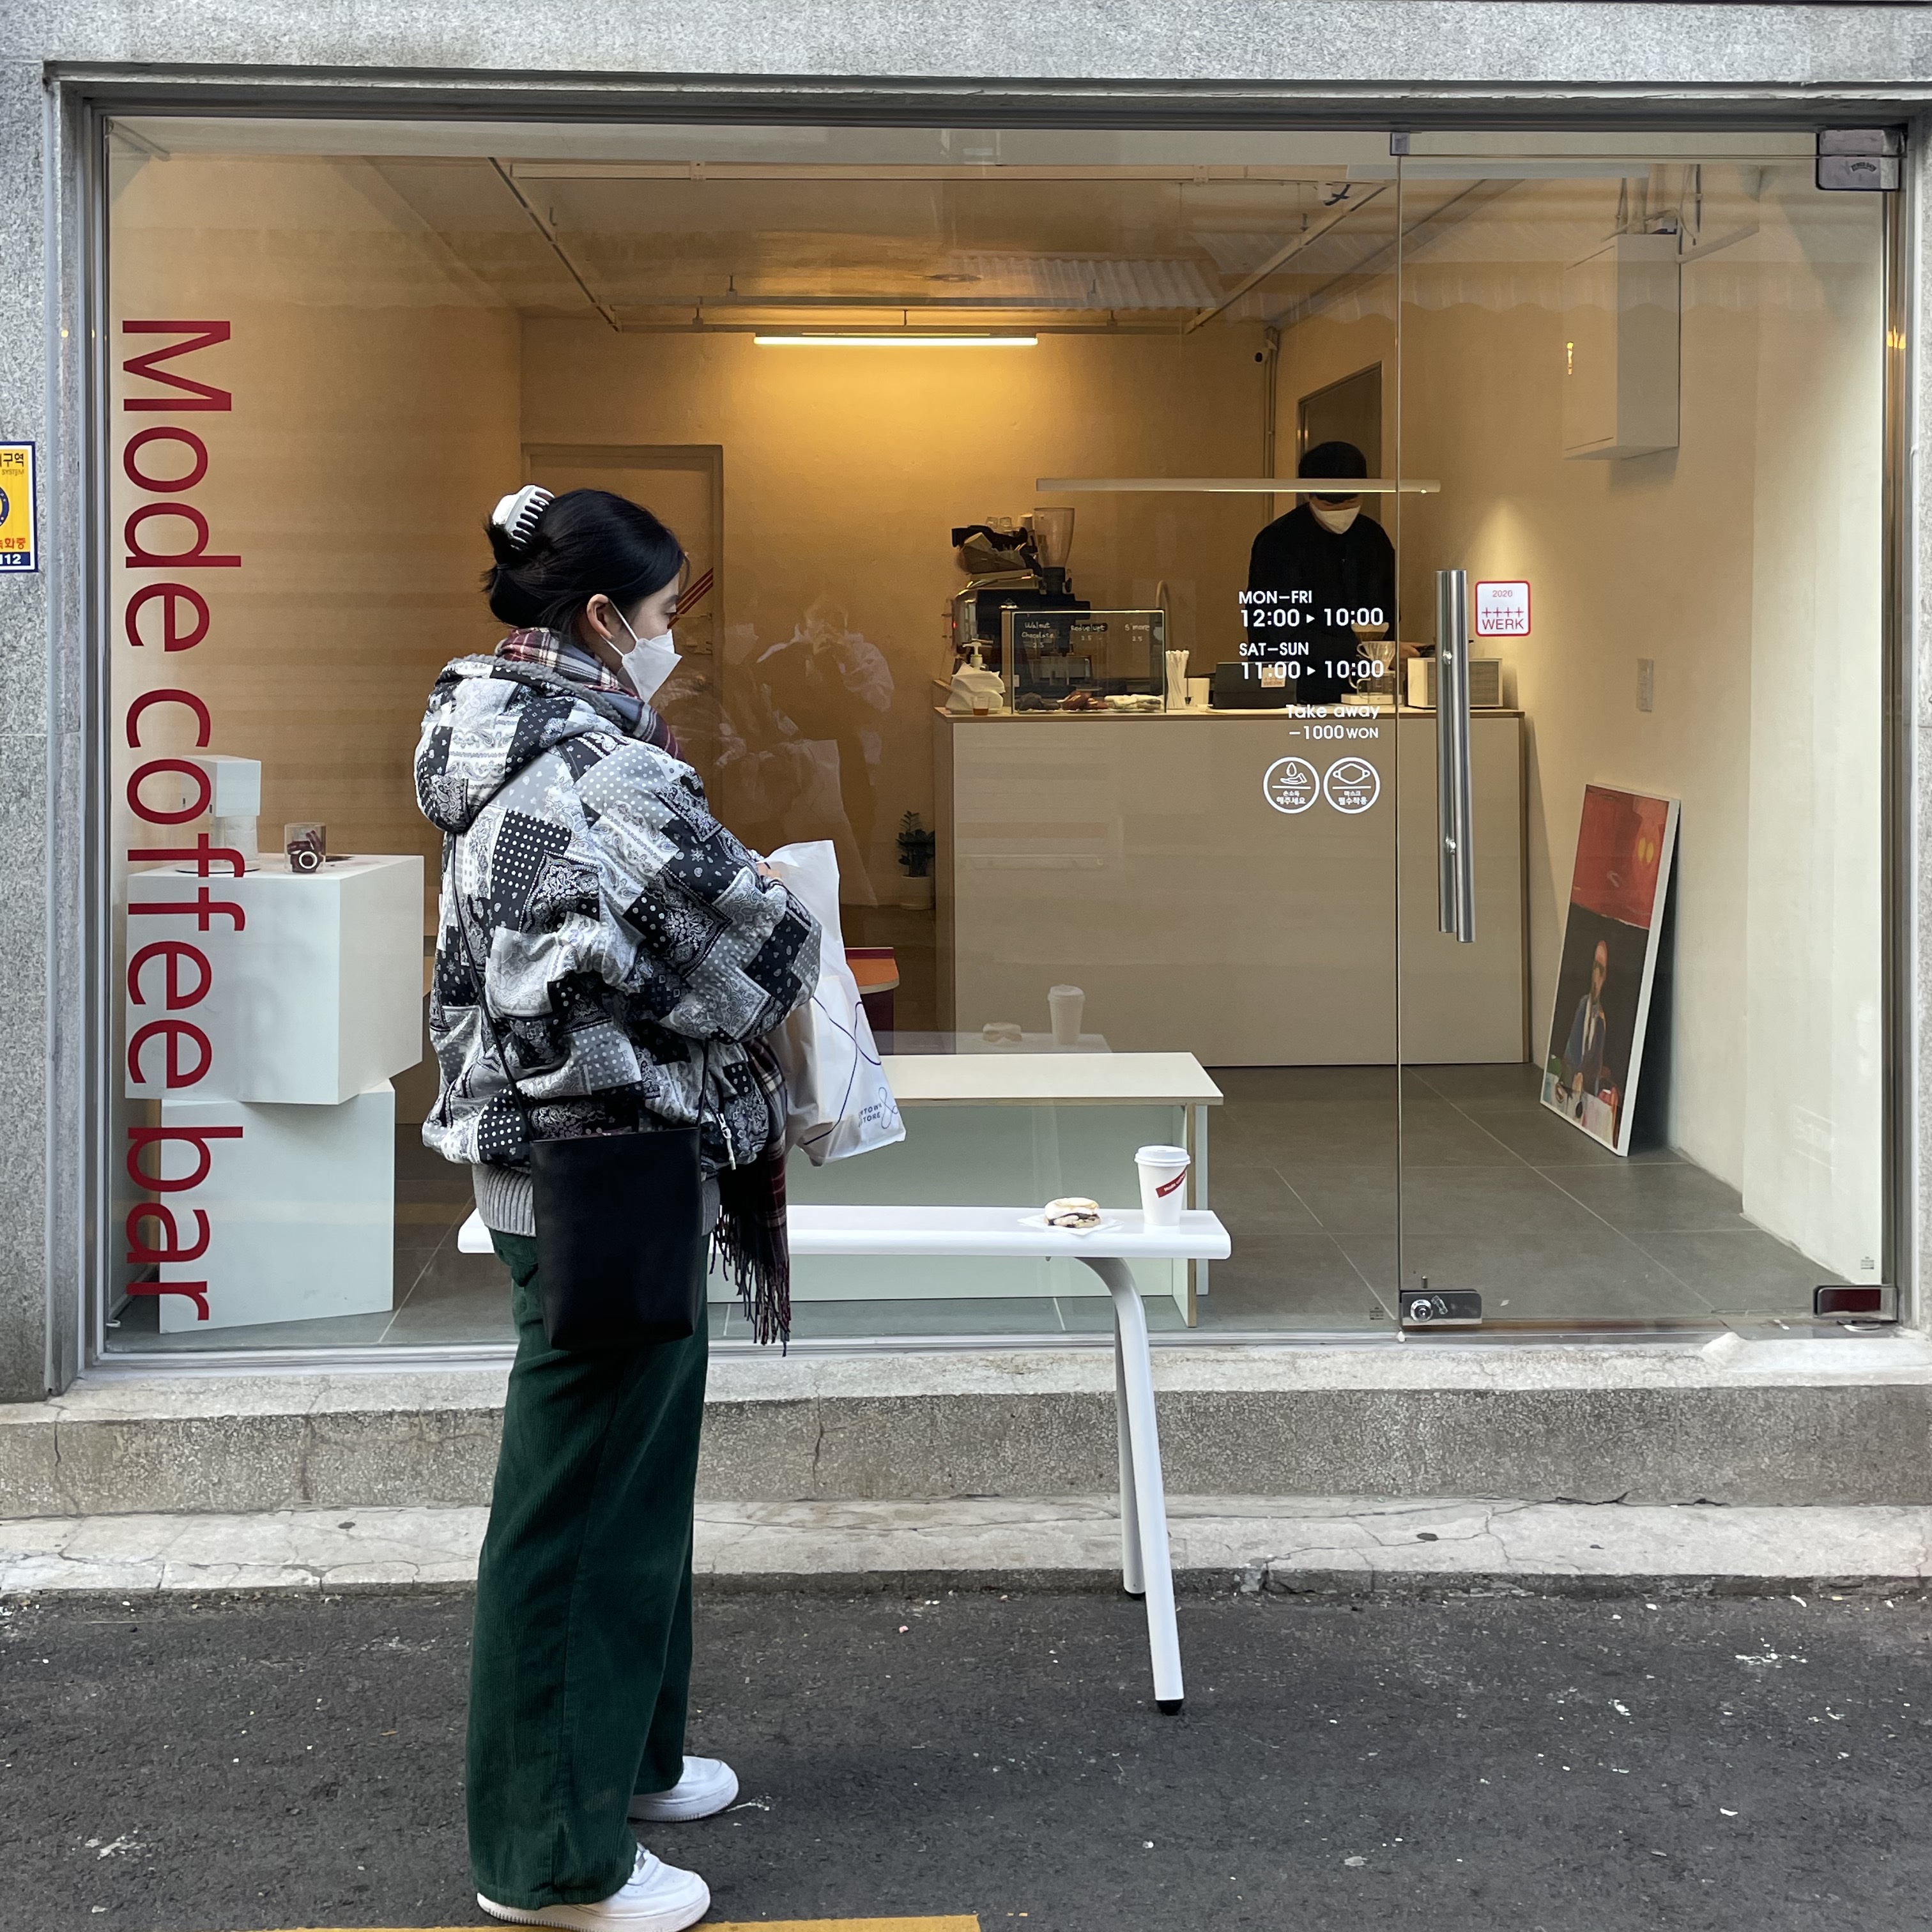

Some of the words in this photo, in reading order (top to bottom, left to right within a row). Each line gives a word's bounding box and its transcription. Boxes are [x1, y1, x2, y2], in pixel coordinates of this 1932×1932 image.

[122, 320, 242, 652] Mode
[1238, 590, 1312, 604] MON-FRI
[1492, 590, 1513, 598] 2020
[1241, 608, 1300, 627] 12:00
[1324, 608, 1383, 626] 10:00
[1482, 618, 1524, 630] WERK
[1238, 641, 1309, 656] SAT-SUN
[1241, 661, 1301, 680] 11:00
[1324, 660, 1384, 678] 10:00
[1285, 704, 1327, 719] Take
[1333, 705, 1380, 719] away
[1346, 727, 1379, 739] WON
[126, 689, 246, 1087] coffee
[127, 1127, 243, 1320] bar
